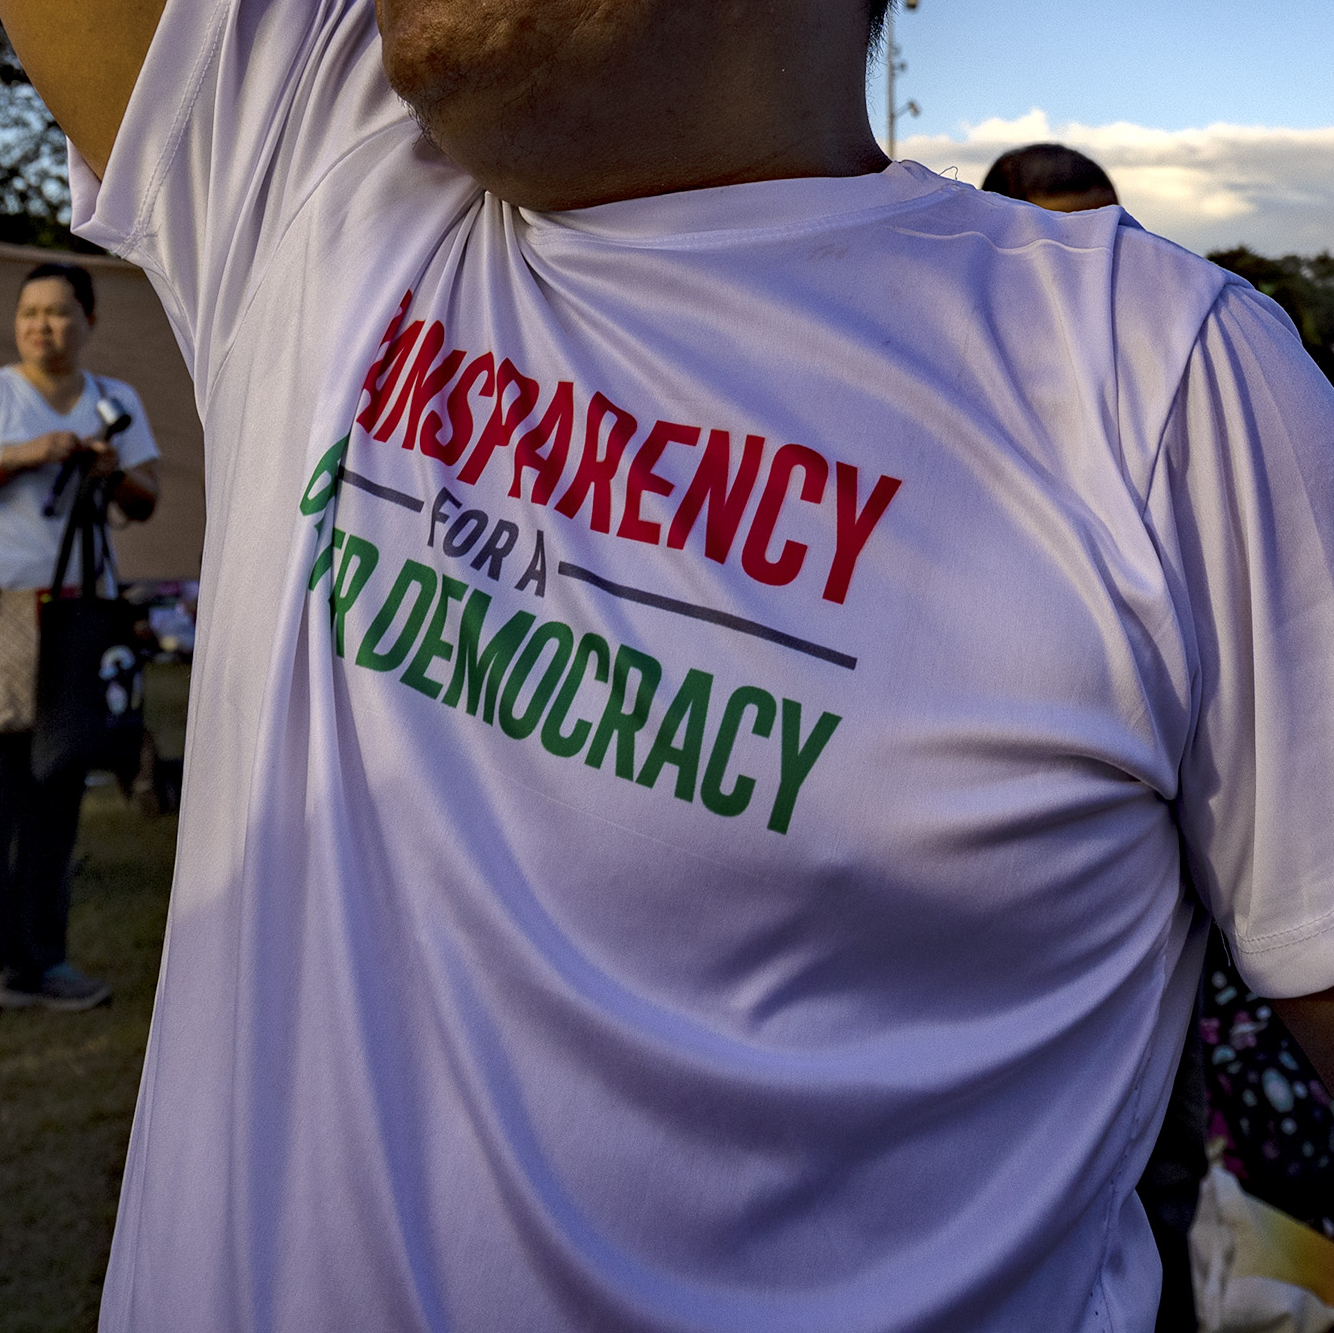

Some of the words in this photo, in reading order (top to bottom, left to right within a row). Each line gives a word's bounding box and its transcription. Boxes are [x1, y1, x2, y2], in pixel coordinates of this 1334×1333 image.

[427, 486, 520, 582] FOR
[514, 529, 547, 598] A
[355, 558, 842, 834] DEMOCRACY
